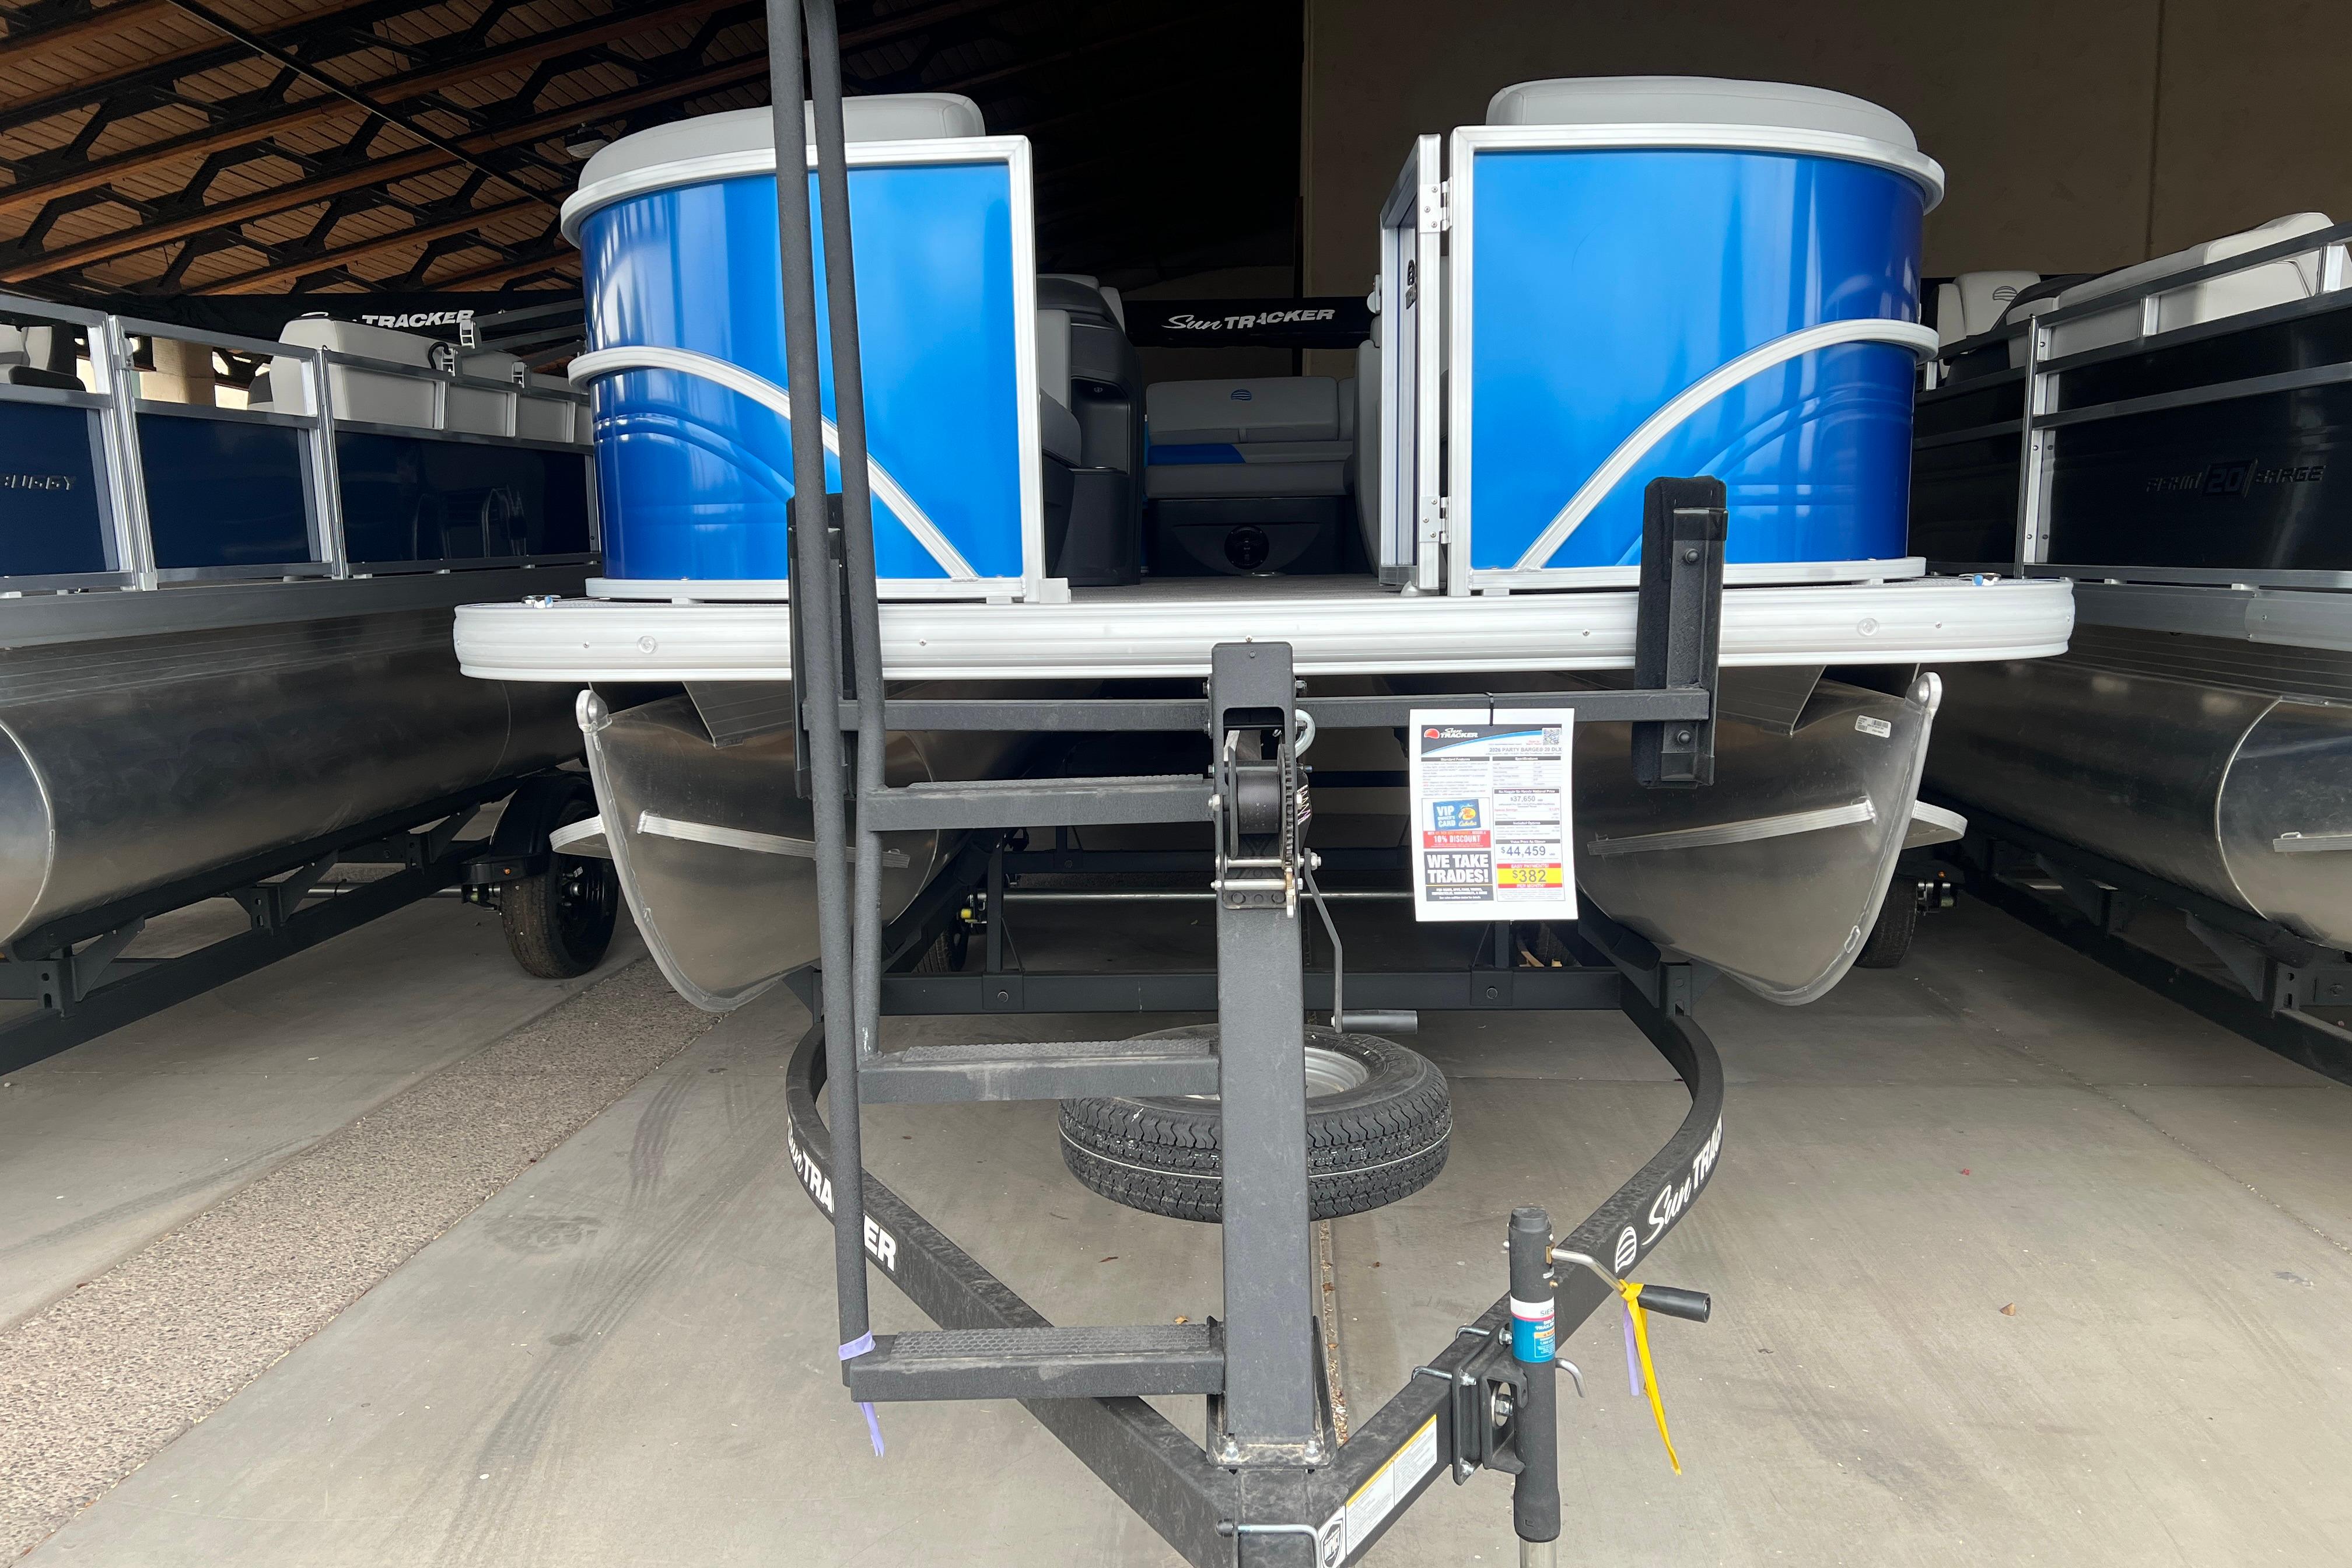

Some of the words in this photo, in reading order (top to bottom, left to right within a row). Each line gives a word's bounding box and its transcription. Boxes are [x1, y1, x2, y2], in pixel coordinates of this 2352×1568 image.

[362, 310, 474, 328] TRACKER
[1161, 314, 1222, 330] Sun
[1224, 309, 1335, 330] TRACKER
[1436, 805, 1454, 816] VIP
[1434, 835, 1448, 843] 10%
[1449, 835, 1480, 843] DISCOUNT
[1500, 846, 1546, 858] $44,459
[1427, 854, 1450, 868] WE
[1452, 854, 1489, 868] TAKE
[1427, 869, 1489, 883] TRADES!
[1512, 869, 1546, 883] $382
[1642, 1176, 1692, 1246] Sun
[1693, 1112, 1723, 1190] TRAC
[803, 1149, 897, 1272] TRAER
[1540, 1306, 1555, 1317] SIER
